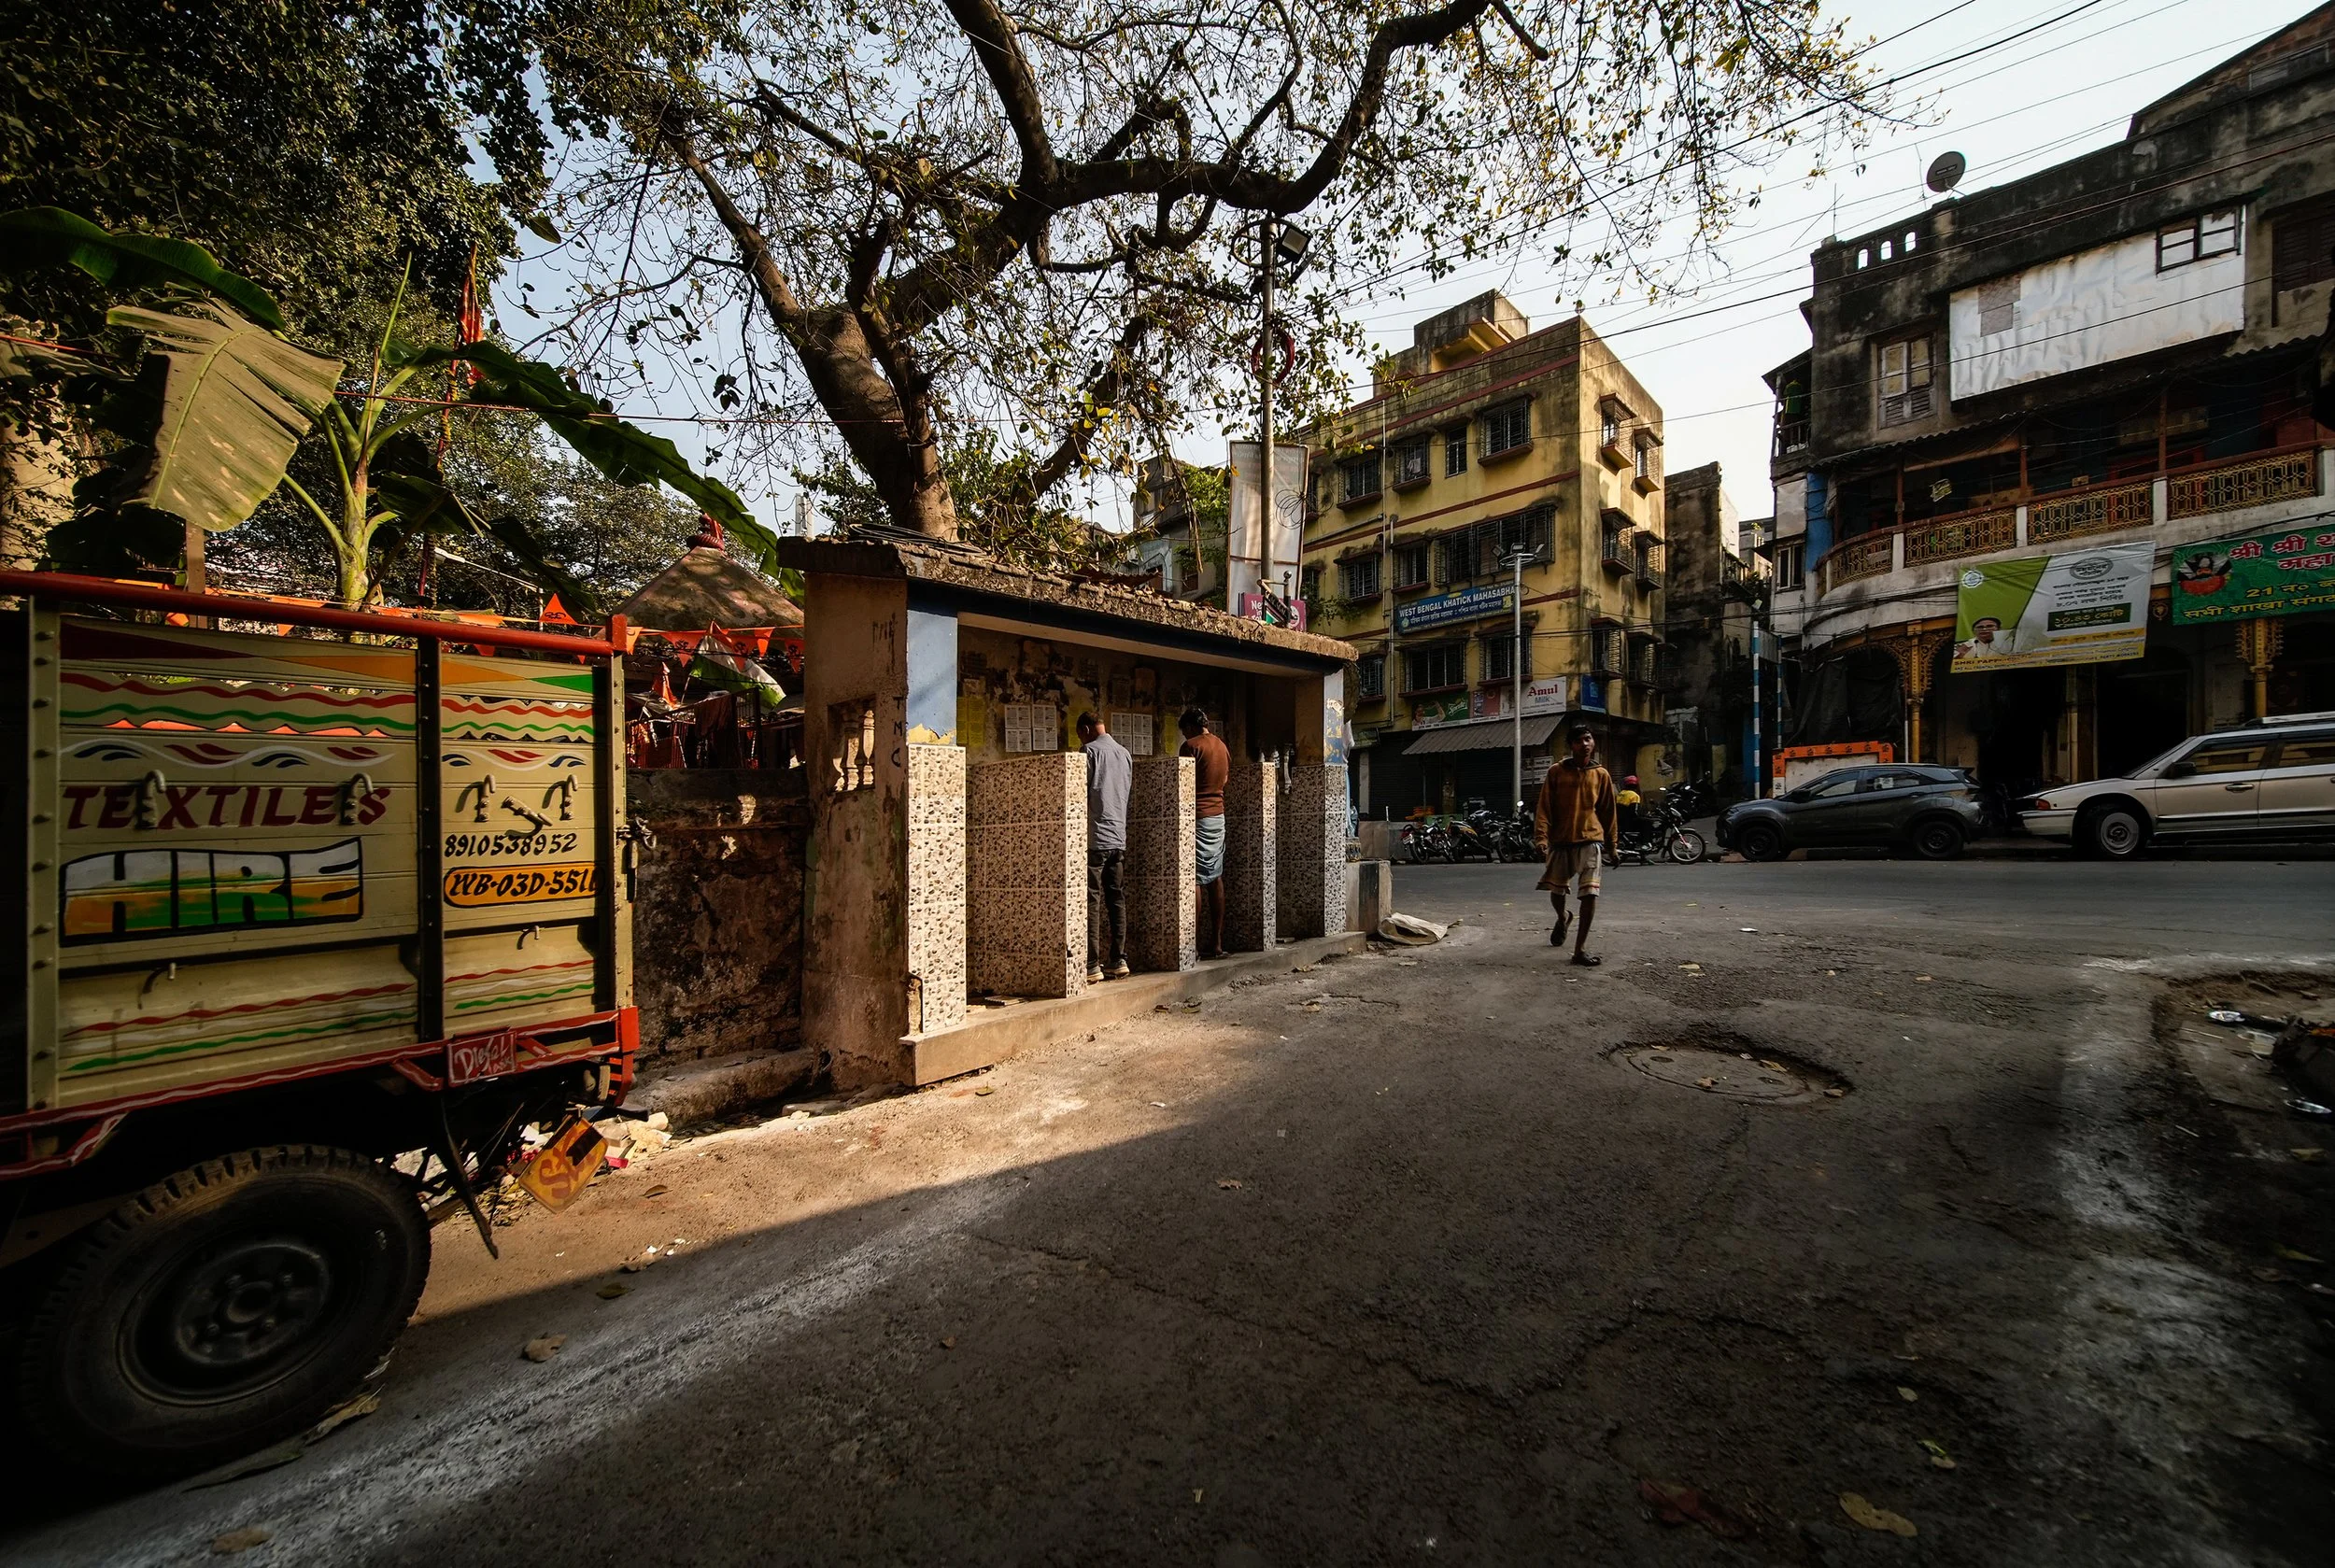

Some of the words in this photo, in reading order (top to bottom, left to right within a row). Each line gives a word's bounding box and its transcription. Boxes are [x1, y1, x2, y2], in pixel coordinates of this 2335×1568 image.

[2230, 540, 2263, 559] श्री
[2273, 533, 2307, 554] श्री
[1399, 606, 1417, 617] WEST
[1417, 601, 1442, 614] BENGAL
[1443, 595, 1472, 609] KHATICK
[1473, 586, 1515, 602] MAHASABHA
[2245, 586, 2273, 598] 21
[1251, 600, 1263, 610] Ne
[2184, 605, 2225, 618] सभी
[1528, 684, 1558, 697] Amul
[63, 785, 390, 830] TEXTILES
[444, 832, 578, 857] 8910538952
[59, 837, 364, 947] HIRE
